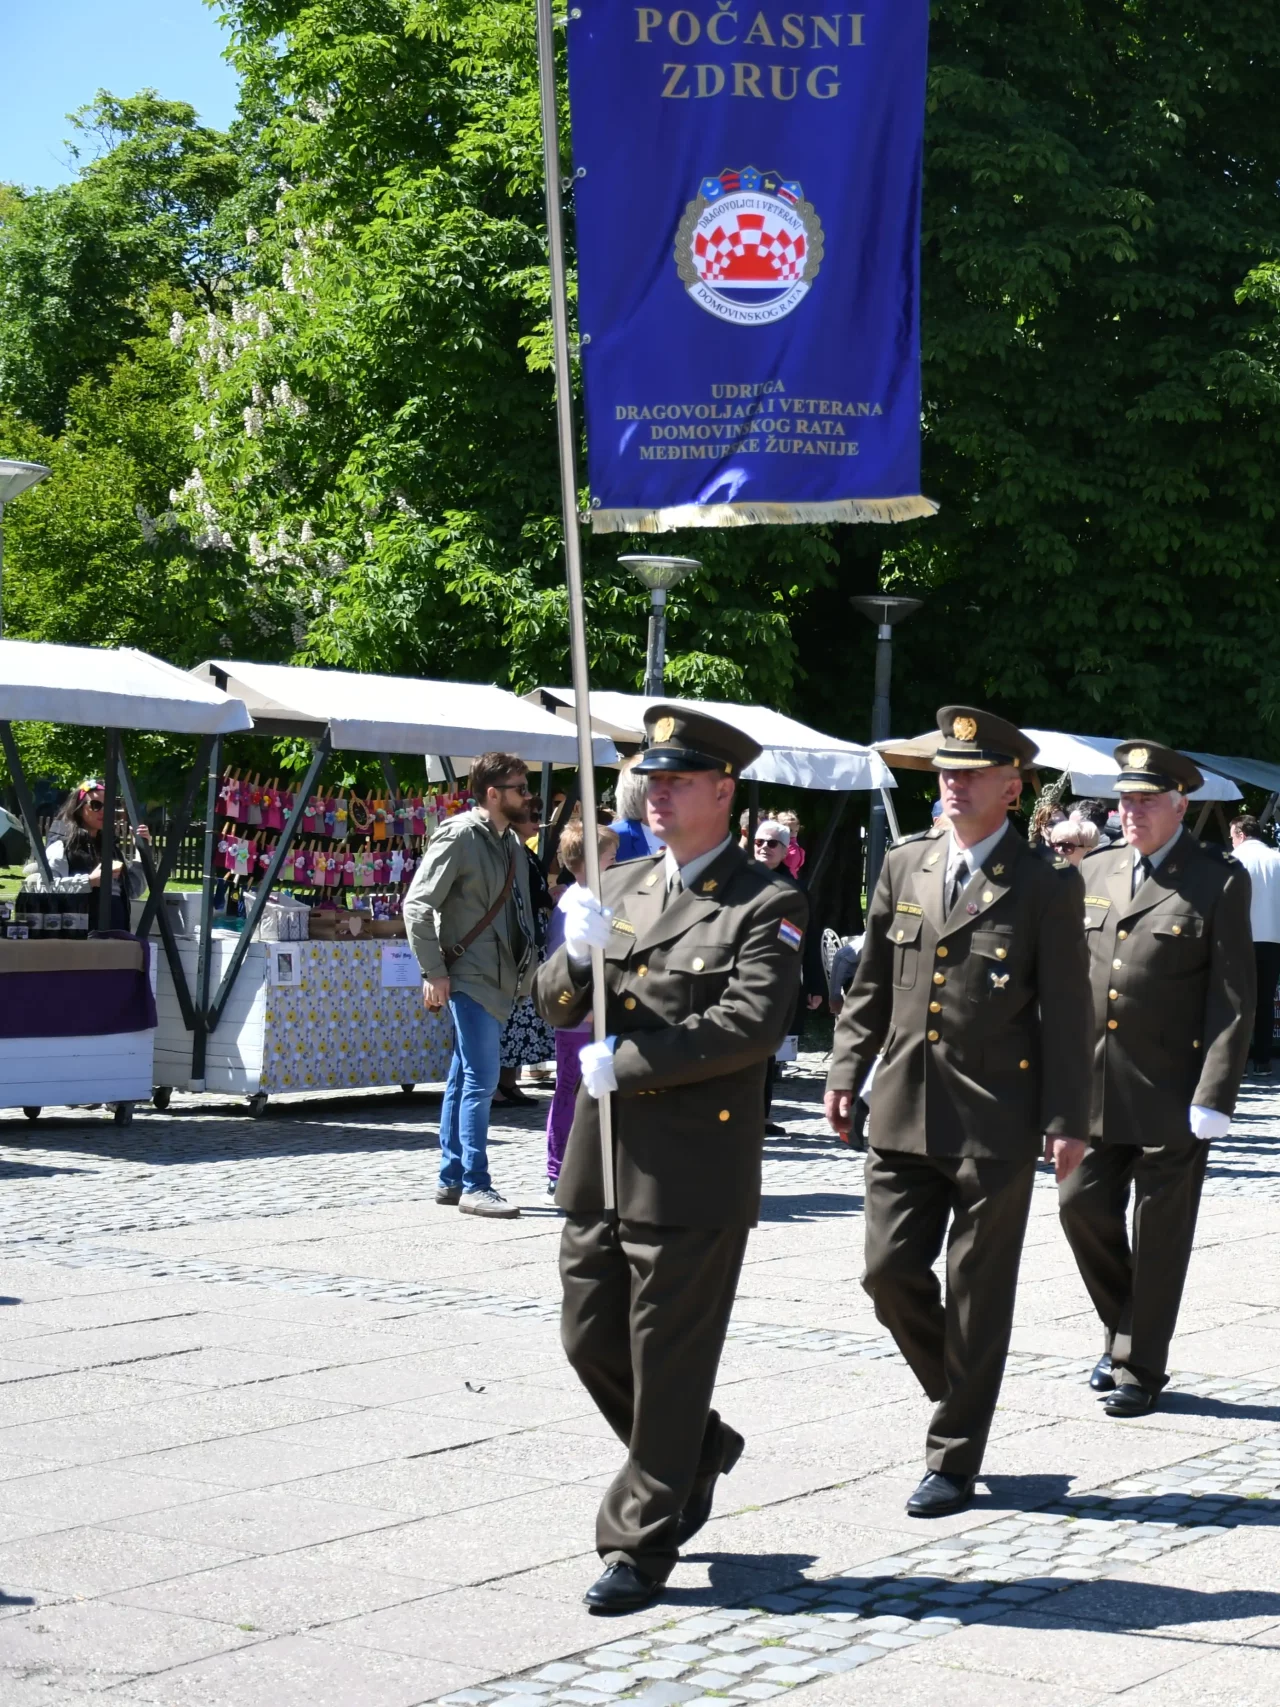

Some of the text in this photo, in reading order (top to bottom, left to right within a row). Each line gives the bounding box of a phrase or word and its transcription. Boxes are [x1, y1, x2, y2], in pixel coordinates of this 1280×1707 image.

[634, 0, 866, 49] POČASNI
[660, 62, 842, 101] ZDRUG
[698, 198, 754, 229] DRAGOVOLJCI
[762, 200, 802, 230] VETERANI
[697, 288, 803, 321] DOMOVINSKOG RATA
[711, 379, 786, 399] UDRUGA
[615, 398, 883, 420] DRAGOVOLJACA I VETERANA
[651, 418, 846, 440] DOMOVINSKOG RATA
[639, 435, 860, 460] MEĐIMURSKE ŽUPANIJE
